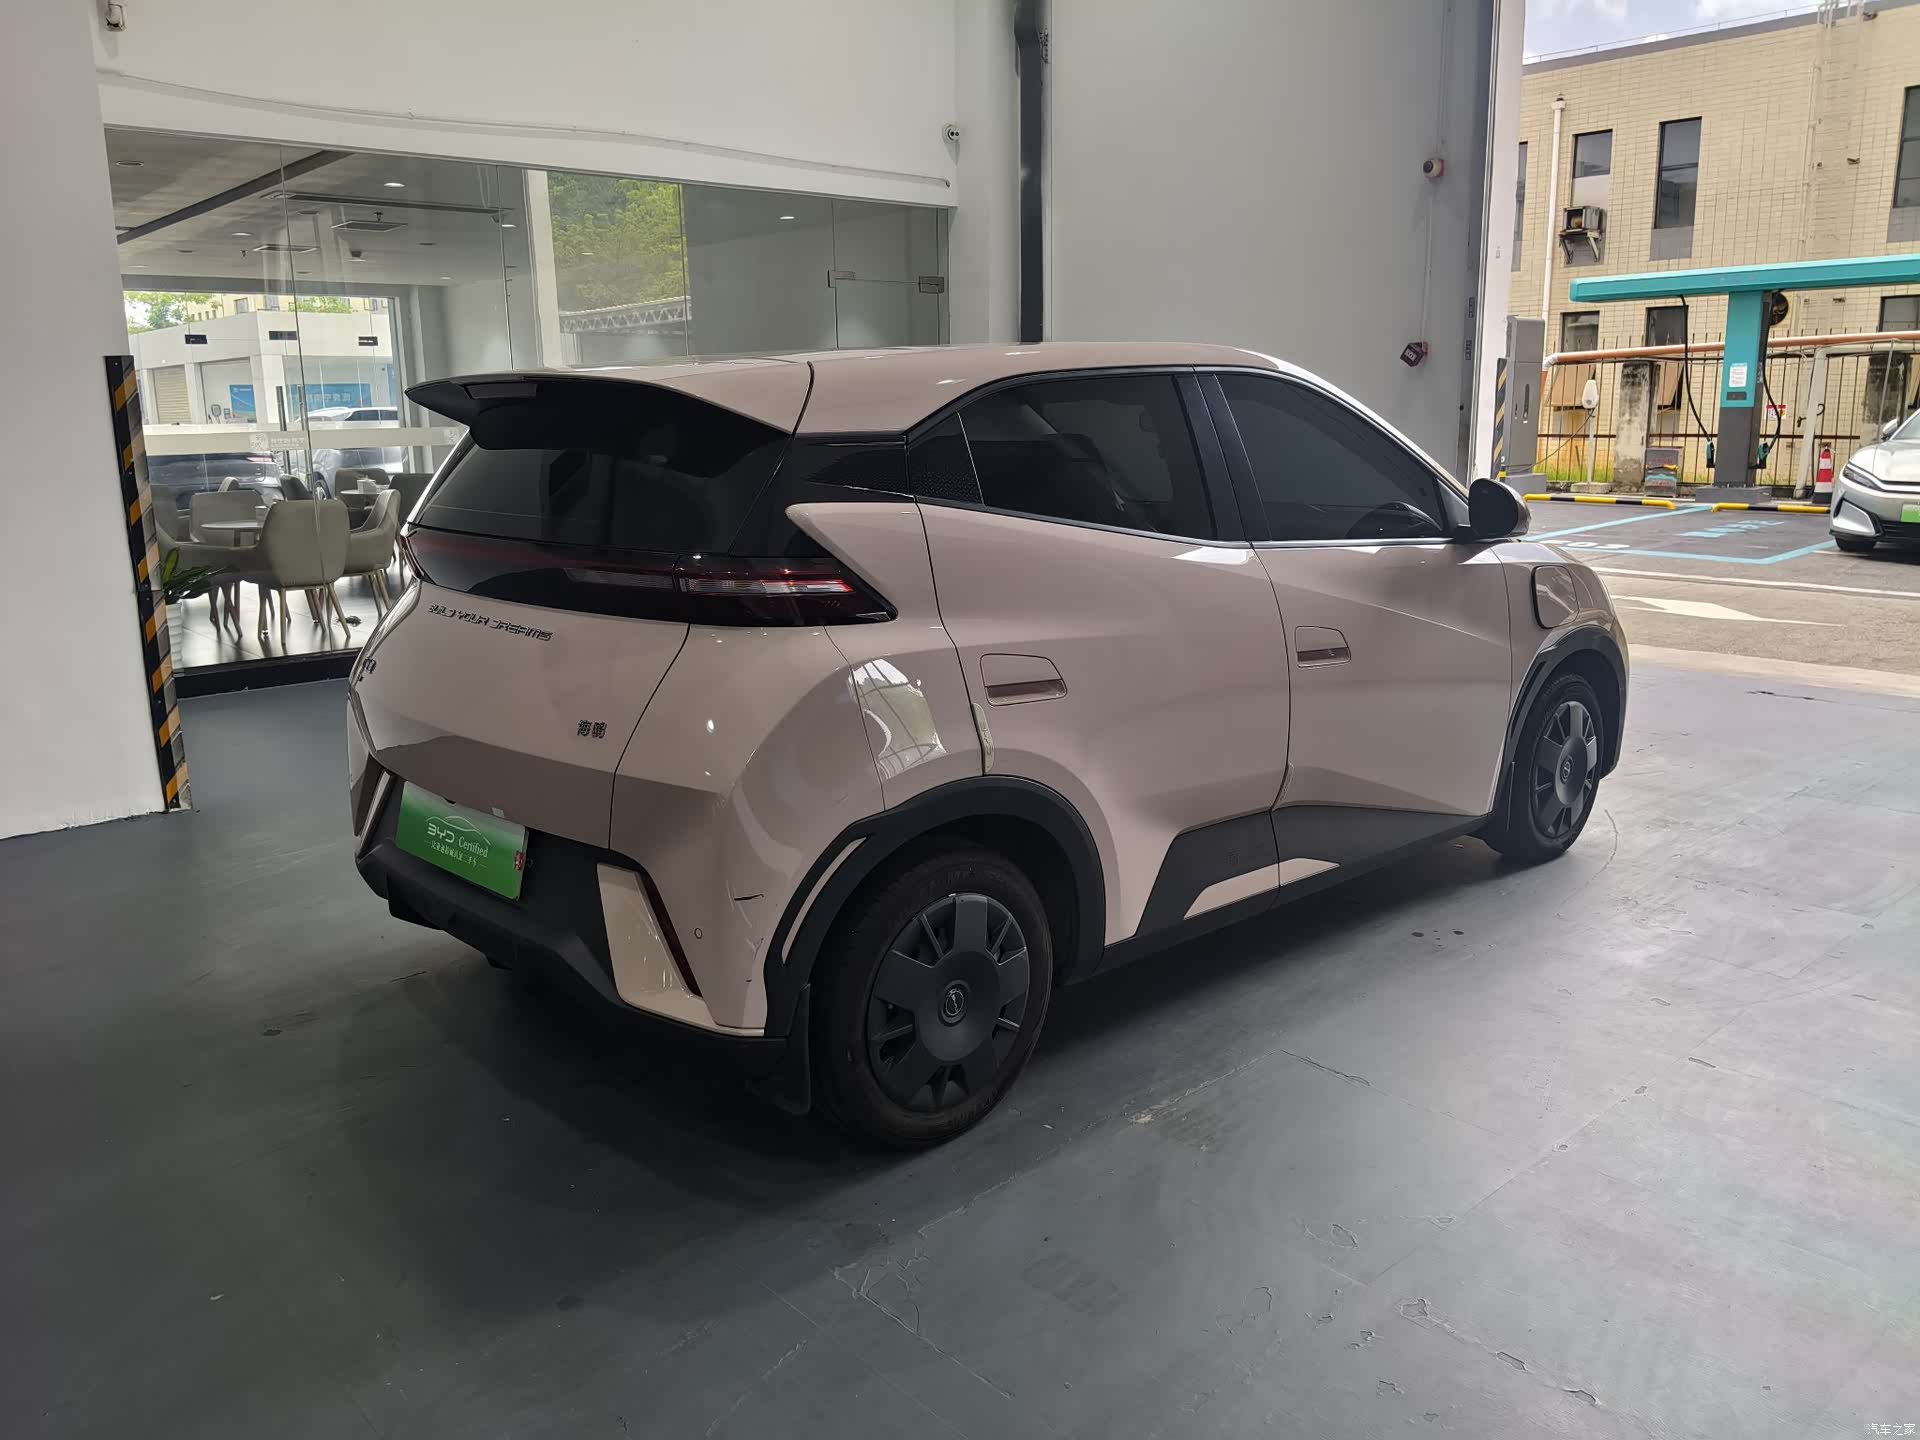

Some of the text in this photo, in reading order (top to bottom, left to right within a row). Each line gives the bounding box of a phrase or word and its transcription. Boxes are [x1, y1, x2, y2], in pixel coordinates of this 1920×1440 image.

[428, 604, 554, 642] BUILD YOUR DREAMS
[427, 822, 489, 858] BYD Certified
